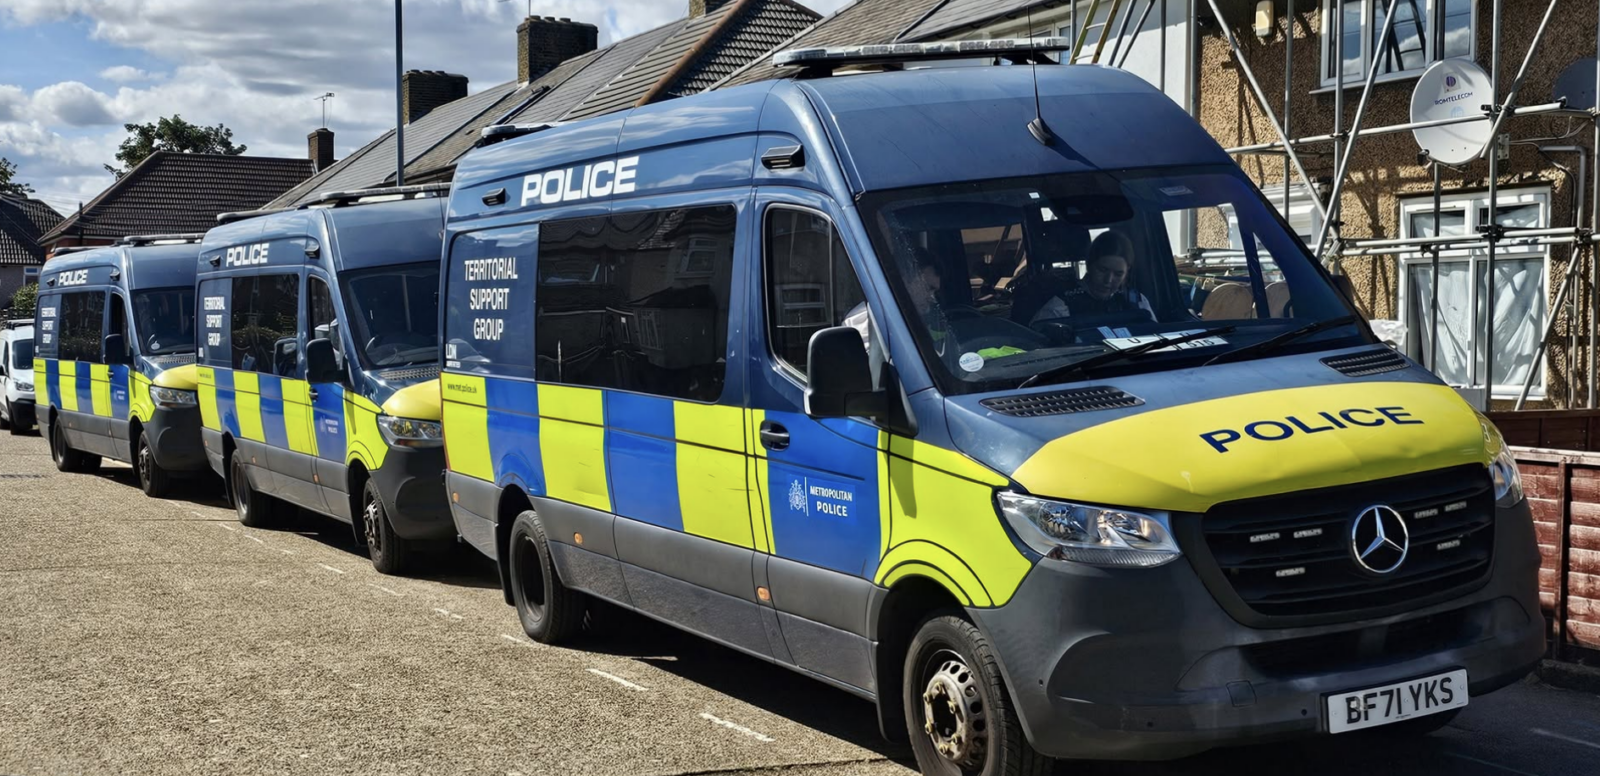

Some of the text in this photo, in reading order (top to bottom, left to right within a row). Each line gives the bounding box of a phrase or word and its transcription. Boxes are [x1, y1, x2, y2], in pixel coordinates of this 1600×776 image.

[1434, 92, 1473, 105] ROMTELECOM
[521, 156, 639, 207] POLICE
[226, 243, 270, 267] POLICE
[58, 268, 89, 287] POLICE
[464, 257, 518, 281] TERRITORIAL
[469, 287, 510, 311] SUPPORT
[473, 317, 504, 341] GROUP
[1199, 406, 1425, 454] POLICE
[810, 485, 852, 502] METROPOLITAN
[816, 501, 848, 517] POLICE
[1345, 677, 1454, 724] BF71 YKS
